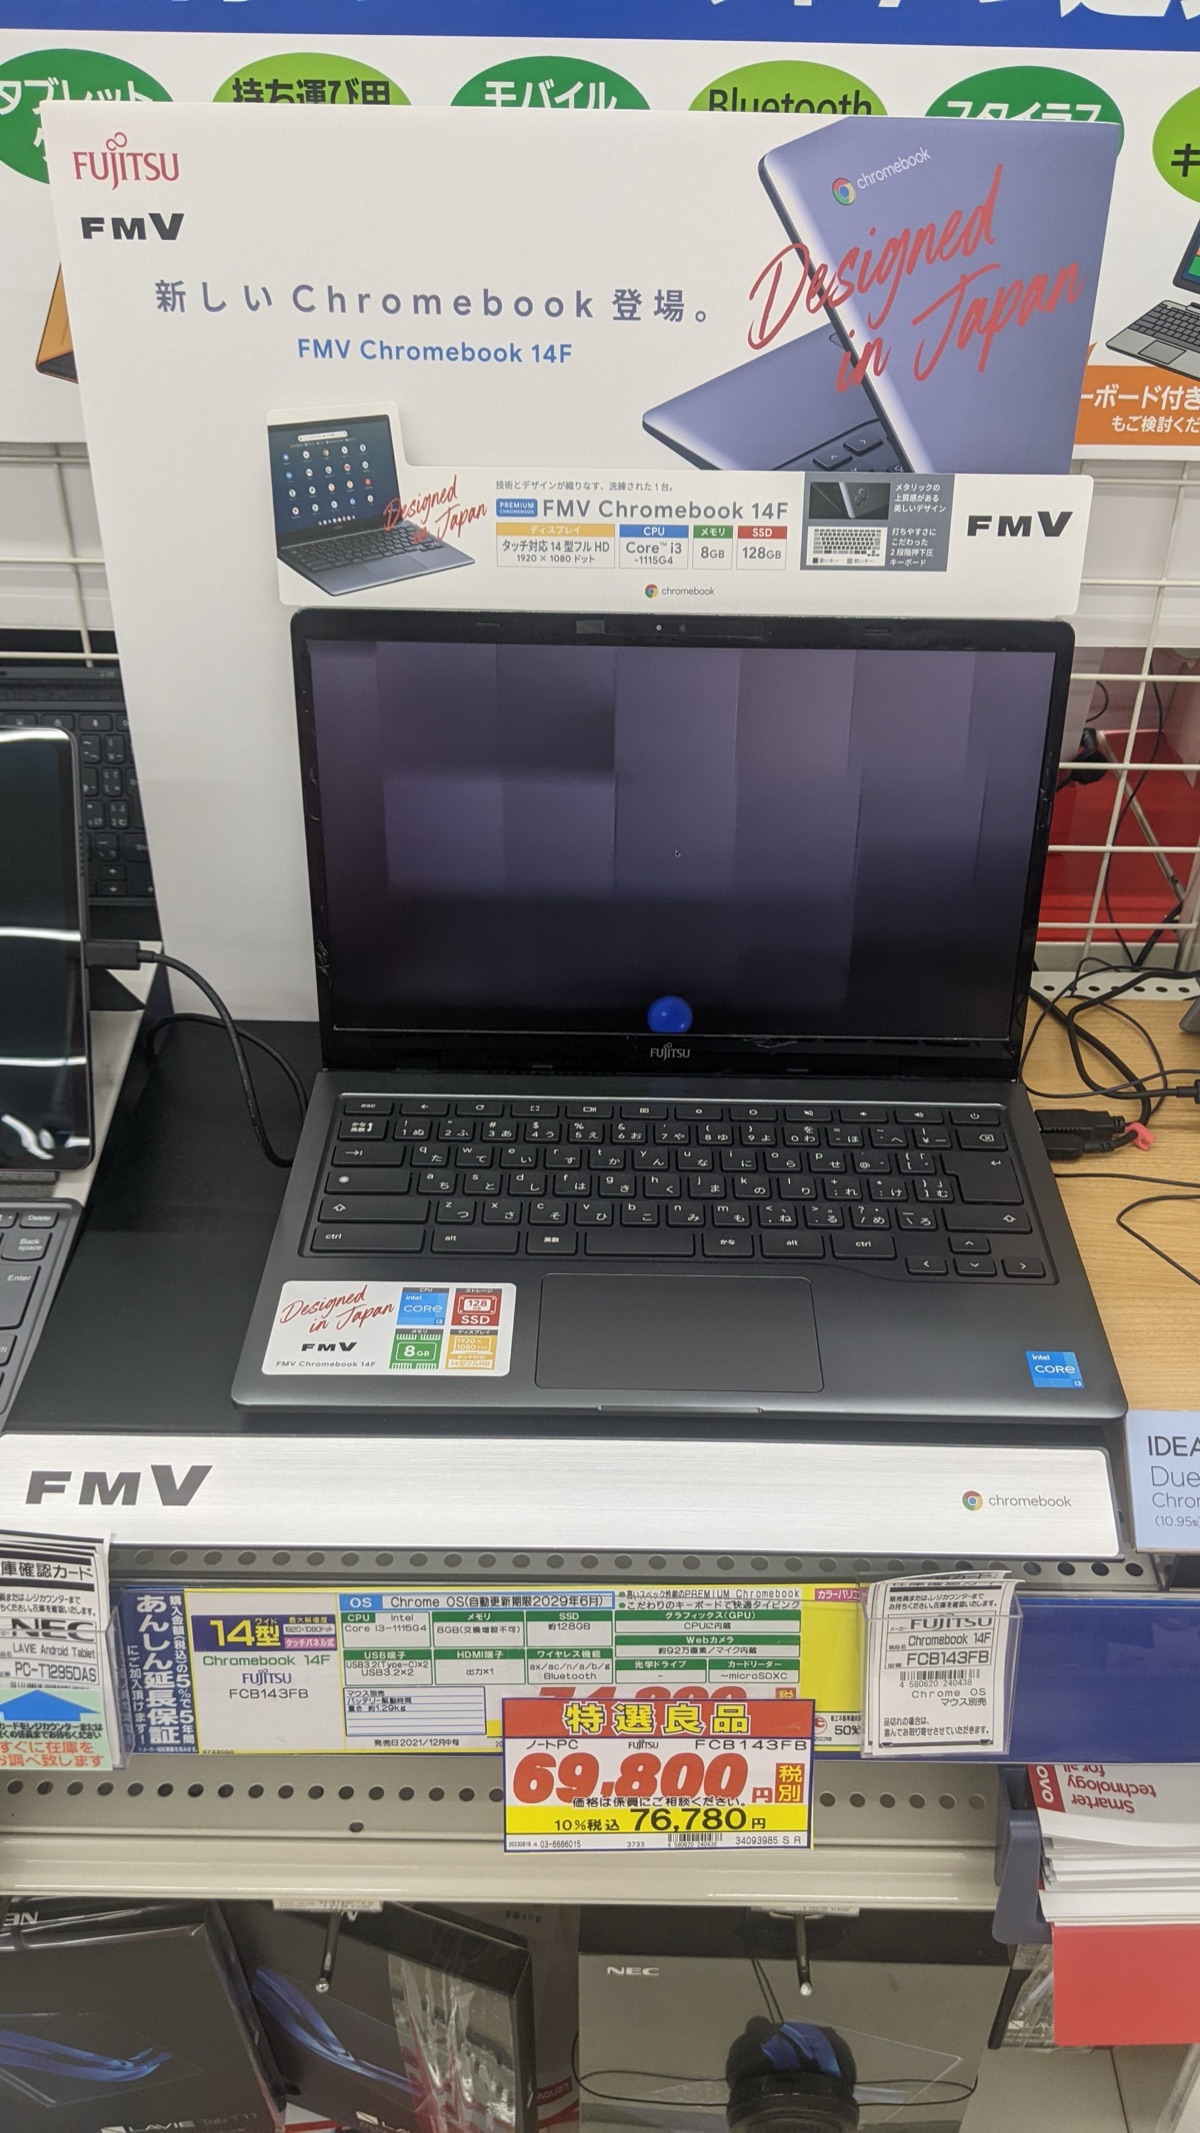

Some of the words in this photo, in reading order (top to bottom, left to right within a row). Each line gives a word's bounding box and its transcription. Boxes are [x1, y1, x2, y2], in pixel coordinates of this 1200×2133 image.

[708, 87, 872, 115] Bluetooth
[72, 132, 180, 191] FUJITSU
[856, 147, 932, 191] chromebook
[80, 212, 186, 241] FMV
[747, 164, 1004, 351] Designed
[836, 329, 891, 393] in
[911, 262, 1086, 382] Japan
[297, 338, 351, 360] FMV
[360, 339, 523, 363] Chromebook
[531, 344, 574, 364] 14F
[895, 483, 941, 492] メタリックの
[382, 474, 458, 531] Designed
[894, 493, 940, 503] 上質感がある
[499, 502, 535, 510] PREMIUM
[542, 499, 591, 518] FMV
[598, 500, 744, 519] Chromebook
[751, 502, 789, 520] 14F
[893, 504, 947, 513] 美しいデザイン
[434, 501, 487, 541] Japan
[966, 510, 1074, 538] FMV
[529, 524, 581, 535] ディスプレイ
[643, 526, 666, 537] CPU
[700, 526, 726, 538] メモリ
[752, 527, 773, 538] SSD
[891, 527, 937, 536] 打ちやすさに
[502, 539, 549, 552] タッチ対応
[550, 541, 562, 552] 14
[564, 540, 593, 552] 型フル
[594, 542, 610, 552] HD
[891, 538, 928, 546] こだわった
[670, 541, 682, 555] i3
[700, 546, 725, 559] 8GB
[742, 546, 782, 560] 128GB
[516, 554, 537, 563] 1920
[550, 554, 572, 563] 1080
[574, 554, 595, 564] ドット
[634, 555, 674, 565] -1115G4
[890, 558, 927, 567] キーボード
[661, 586, 715, 596] chromebook
[650, 1042, 691, 1061] FUJITSU
[324, 1232, 343, 1240] ctrl
[785, 1238, 799, 1246] alt
[854, 1239, 873, 1247] ctrl
[18, 1244, 43, 1252] space
[279, 1284, 368, 1324] Designed
[467, 1299, 488, 1307] 128
[309, 1318, 329, 1334] in
[335, 1303, 396, 1331] Japan
[460, 1314, 491, 1325] SSD
[300, 1341, 359, 1352] FMV
[403, 1345, 430, 1357] 8GB
[1032, 1353, 1051, 1361] intel
[275, 1360, 297, 1368] FMV
[299, 1360, 358, 1368] Chromebook
[25, 1464, 214, 1507] FMV
[988, 1494, 1073, 1508] chromebook
[1, 1560, 94, 1580] 庫確認カード
[735, 1589, 800, 1598] Chromebook
[350, 1596, 373, 1608] OS
[390, 1596, 440, 1608] Chrome
[347, 1613, 370, 1622] CPU
[390, 1613, 414, 1622] Intel
[467, 1612, 491, 1621] メモリ
[558, 1612, 580, 1621] SSD
[665, 1611, 757, 1620] グラフィックス(GPU)
[547, 1622, 592, 1631] 約128GB
[683, 1622, 732, 1630] CPUに内蔵
[910, 1613, 993, 1632] FUJITSU
[11, 1618, 95, 1642] NEC
[344, 1624, 371, 1633] Core
[285, 1637, 336, 1648] タッチパネル式
[686, 1636, 735, 1645] Webカメラ
[908, 1633, 969, 1647] Chromebook
[974, 1632, 992, 1644] 14F
[12, 1642, 38, 1654] LAVIE
[40, 1644, 70, 1657] Android
[71, 1646, 96, 1659] Tablet
[364, 1650, 406, 1660] USB端子
[456, 1649, 504, 1659] HDMI端子
[536, 1649, 602, 1659] ワイヤレス機能
[202, 1655, 296, 1666] Chromebook
[303, 1655, 331, 1665] 14F
[906, 1650, 990, 1666] FCB143FB
[136, 1595, 182, 1745] あんしん延長保証
[529, 1662, 611, 1671] ax/ac/n/a/b/g
[634, 1660, 687, 1669] 光学ドライブ
[727, 1660, 782, 1669] カードリーダー
[241, 1669, 293, 1685] FUJITSU
[543, 1672, 597, 1681] Bluetooth
[909, 1680, 939, 1688] 580620
[943, 1678, 973, 1687] 240438
[229, 1688, 309, 1700] FCB143FB
[911, 1689, 961, 1699] Chrome
[969, 1687, 987, 1696] OS
[940, 1697, 987, 1707] マウス別売
[562, 1701, 752, 1735] 特選良品
[526, 1739, 579, 1750] ノートPC
[627, 1738, 659, 1750] FUJITSU
[694, 1739, 808, 1751] FCB143FB
[512, 1752, 749, 1804] 69,800
[751, 1786, 773, 1804] 円
[778, 1764, 802, 1803] 税別
[1067, 1775, 1157, 1798] technology
[571, 1796, 747, 1808] 価格は係員にご相談ください。
[1071, 1793, 1135, 1814] Smarter
[629, 1808, 748, 1834] 76,780
[751, 1817, 767, 1830] 円
[540, 1840, 582, 1849] 03-6686015
[626, 1840, 645, 1848] 3733
[735, 1836, 779, 1846] 34093985
[793, 1836, 802, 1844] R
[606, 1966, 660, 1976] NEC
[129, 2120, 196, 2132] LAVIE
